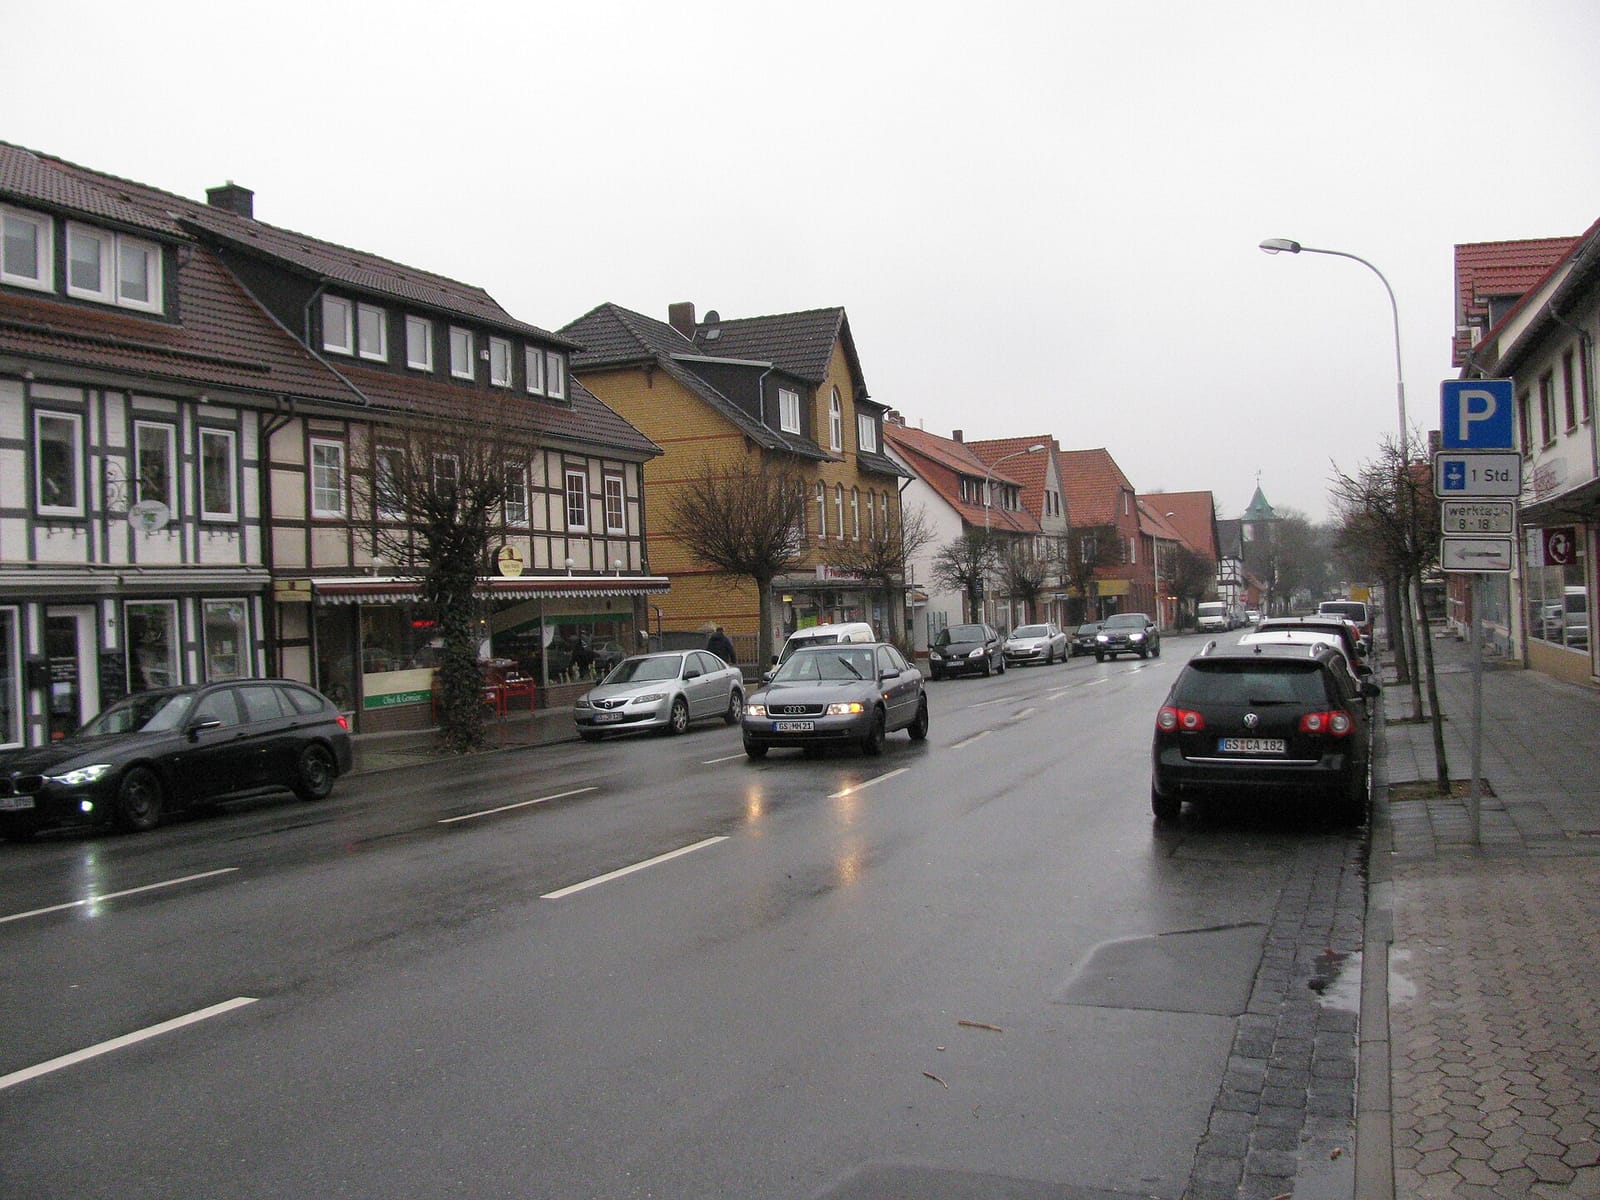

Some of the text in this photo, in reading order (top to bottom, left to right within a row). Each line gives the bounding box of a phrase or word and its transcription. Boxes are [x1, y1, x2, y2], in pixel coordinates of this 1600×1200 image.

[1459, 389, 1497, 441] P
[1471, 469, 1513, 482] 1 Std.
[1459, 518, 1466, 529] 8
[1478, 518, 1489, 529] 18
[1224, 740, 1283, 751] GS CA 182
